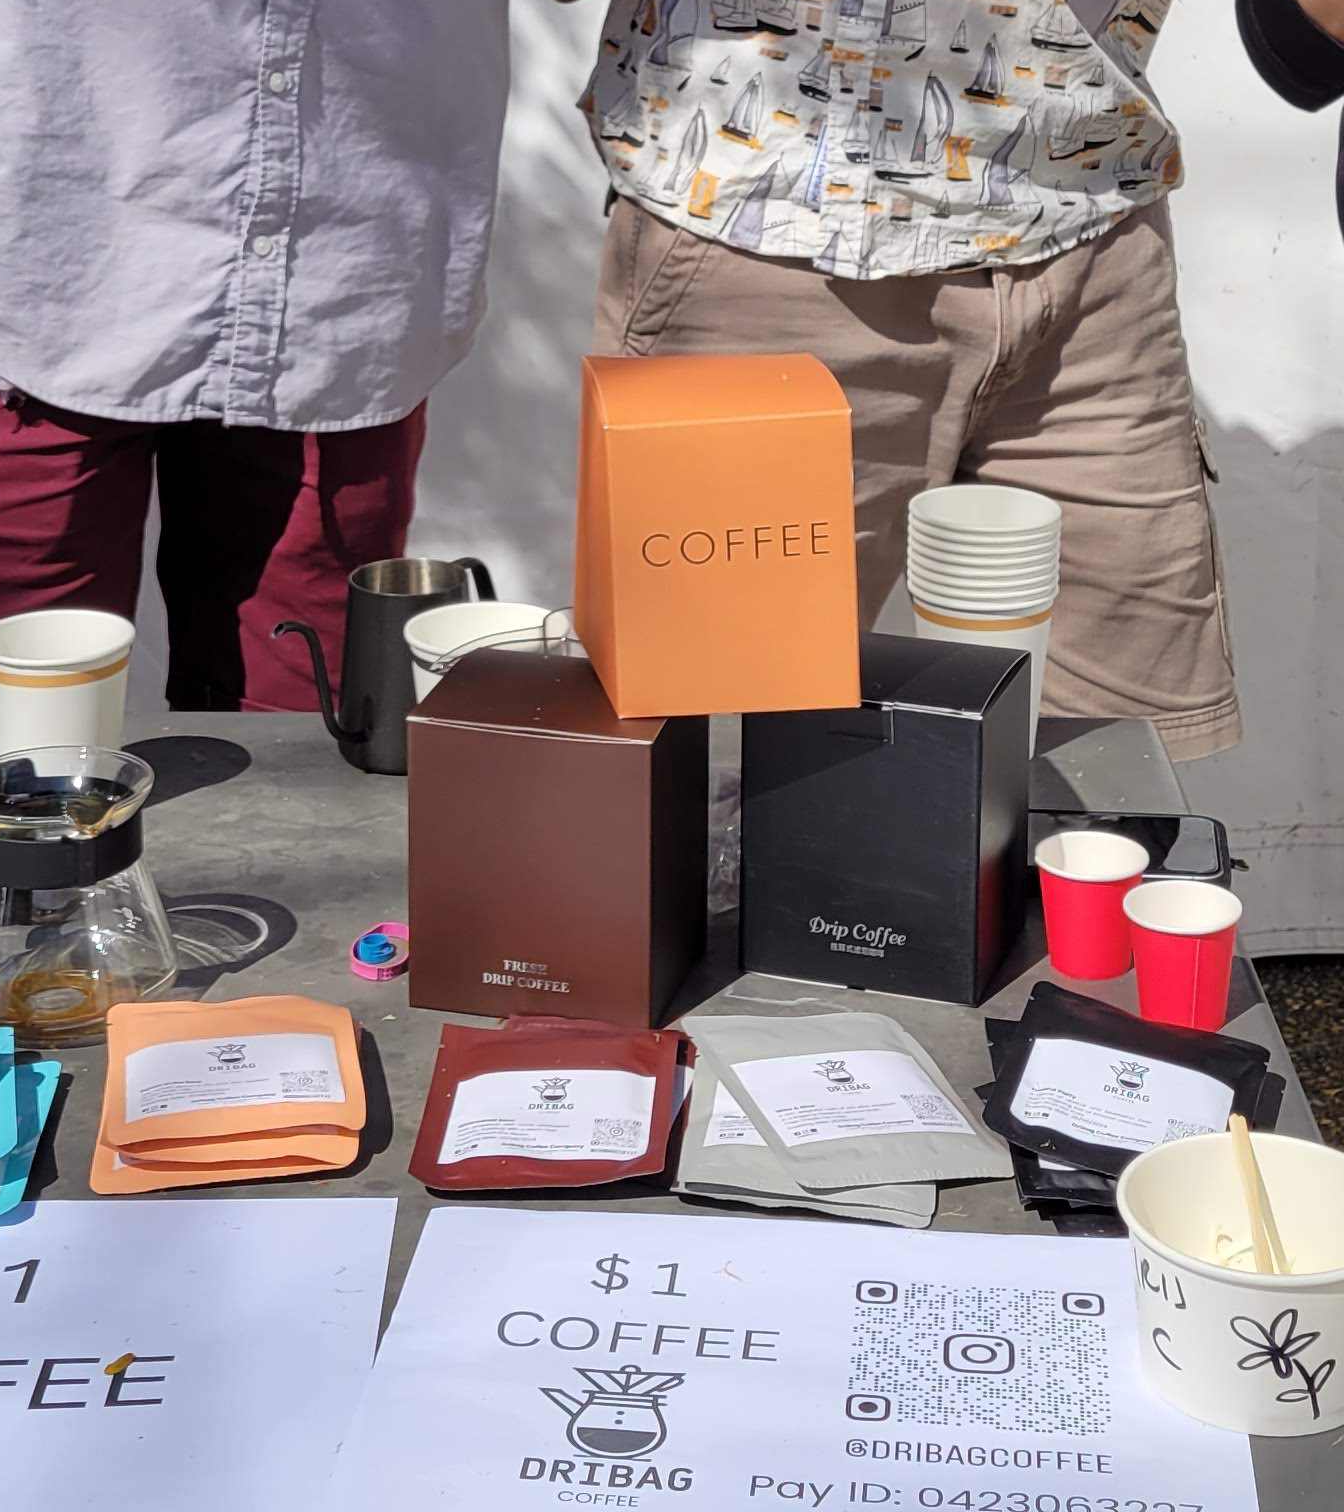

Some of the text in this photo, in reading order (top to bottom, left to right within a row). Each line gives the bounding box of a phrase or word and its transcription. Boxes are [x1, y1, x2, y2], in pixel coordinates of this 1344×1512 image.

[641, 521, 831, 568] COFFEE
[809, 916, 907, 948] Drip Coffee
[482, 972, 570, 993] DRIP COFFEE
[527, 1102, 575, 1111] DRIBAG
[1103, 1084, 1151, 1103] DRIBAG
[496, 1310, 782, 1364] COFFEE
[845, 1438, 1114, 1474] @DRIBAGCOFFEE
[519, 1456, 694, 1492] DRIBAG
[557, 1490, 641, 1508] COFFEE
[749, 1474, 834, 1507] Pay
[848, 1481, 902, 1506] ID:
